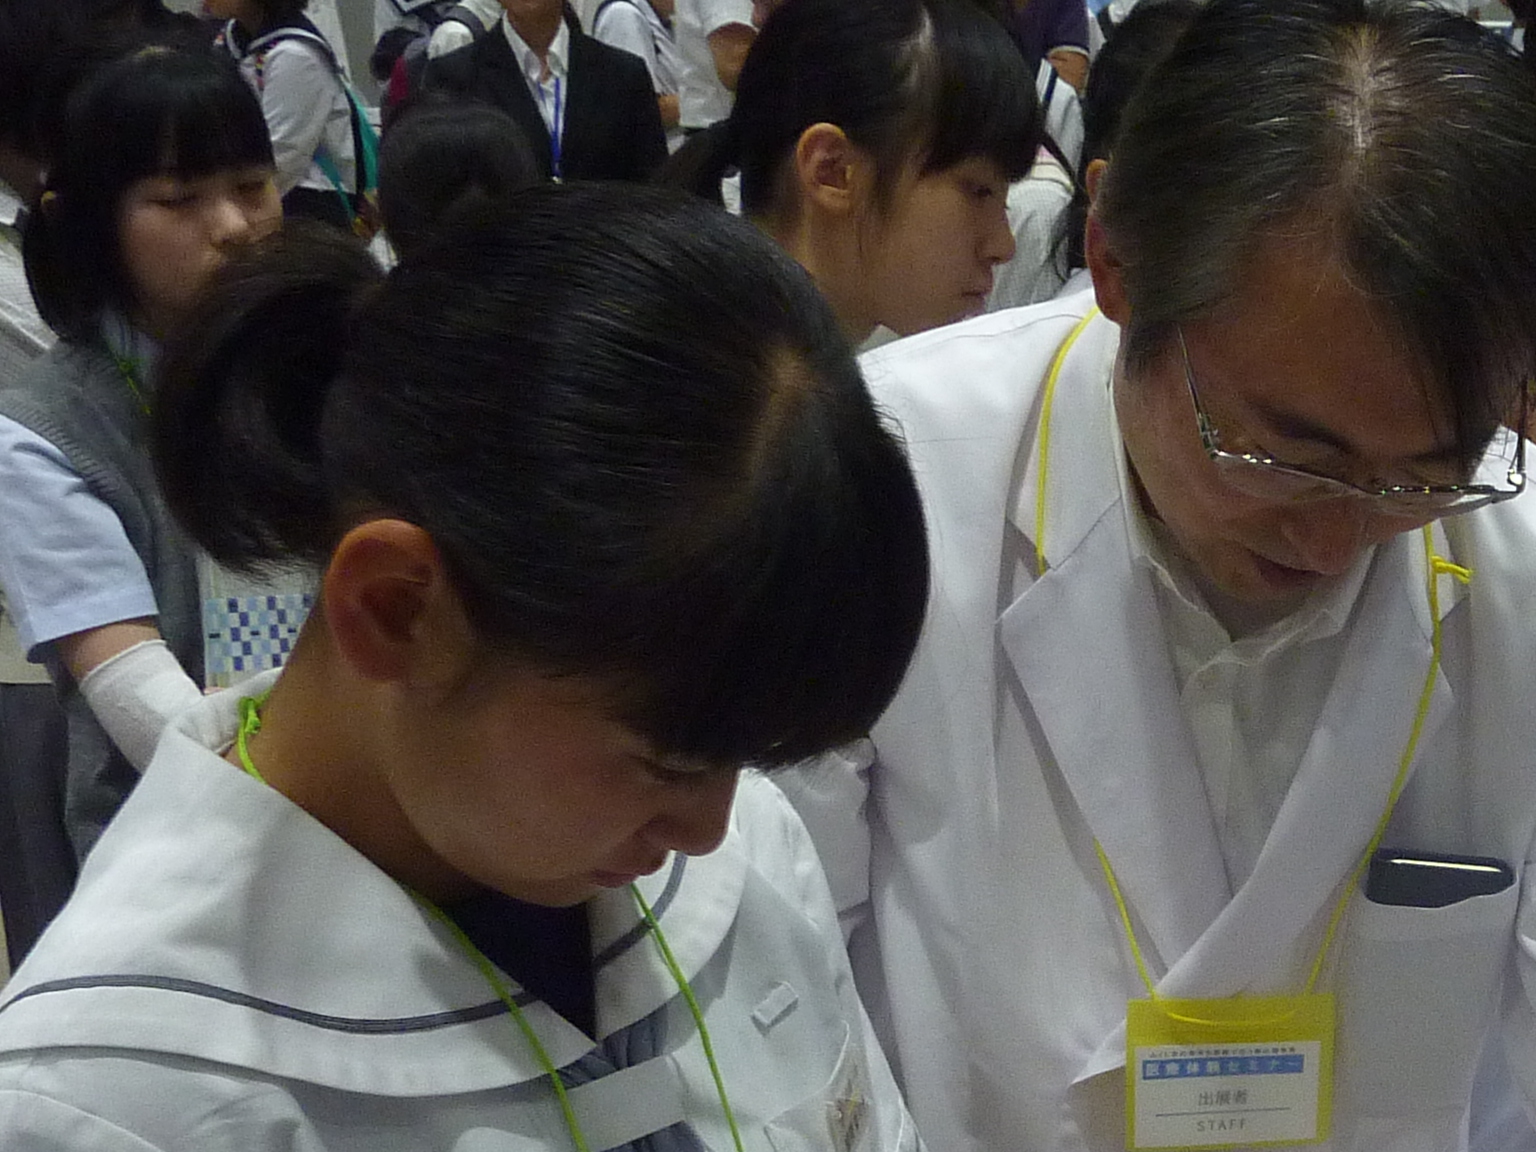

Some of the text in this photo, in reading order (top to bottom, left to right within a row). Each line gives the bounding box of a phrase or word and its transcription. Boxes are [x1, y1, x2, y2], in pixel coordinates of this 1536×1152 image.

[1198, 1089, 1248, 1106] 出展者
[1196, 1117, 1247, 1132] STAFF
